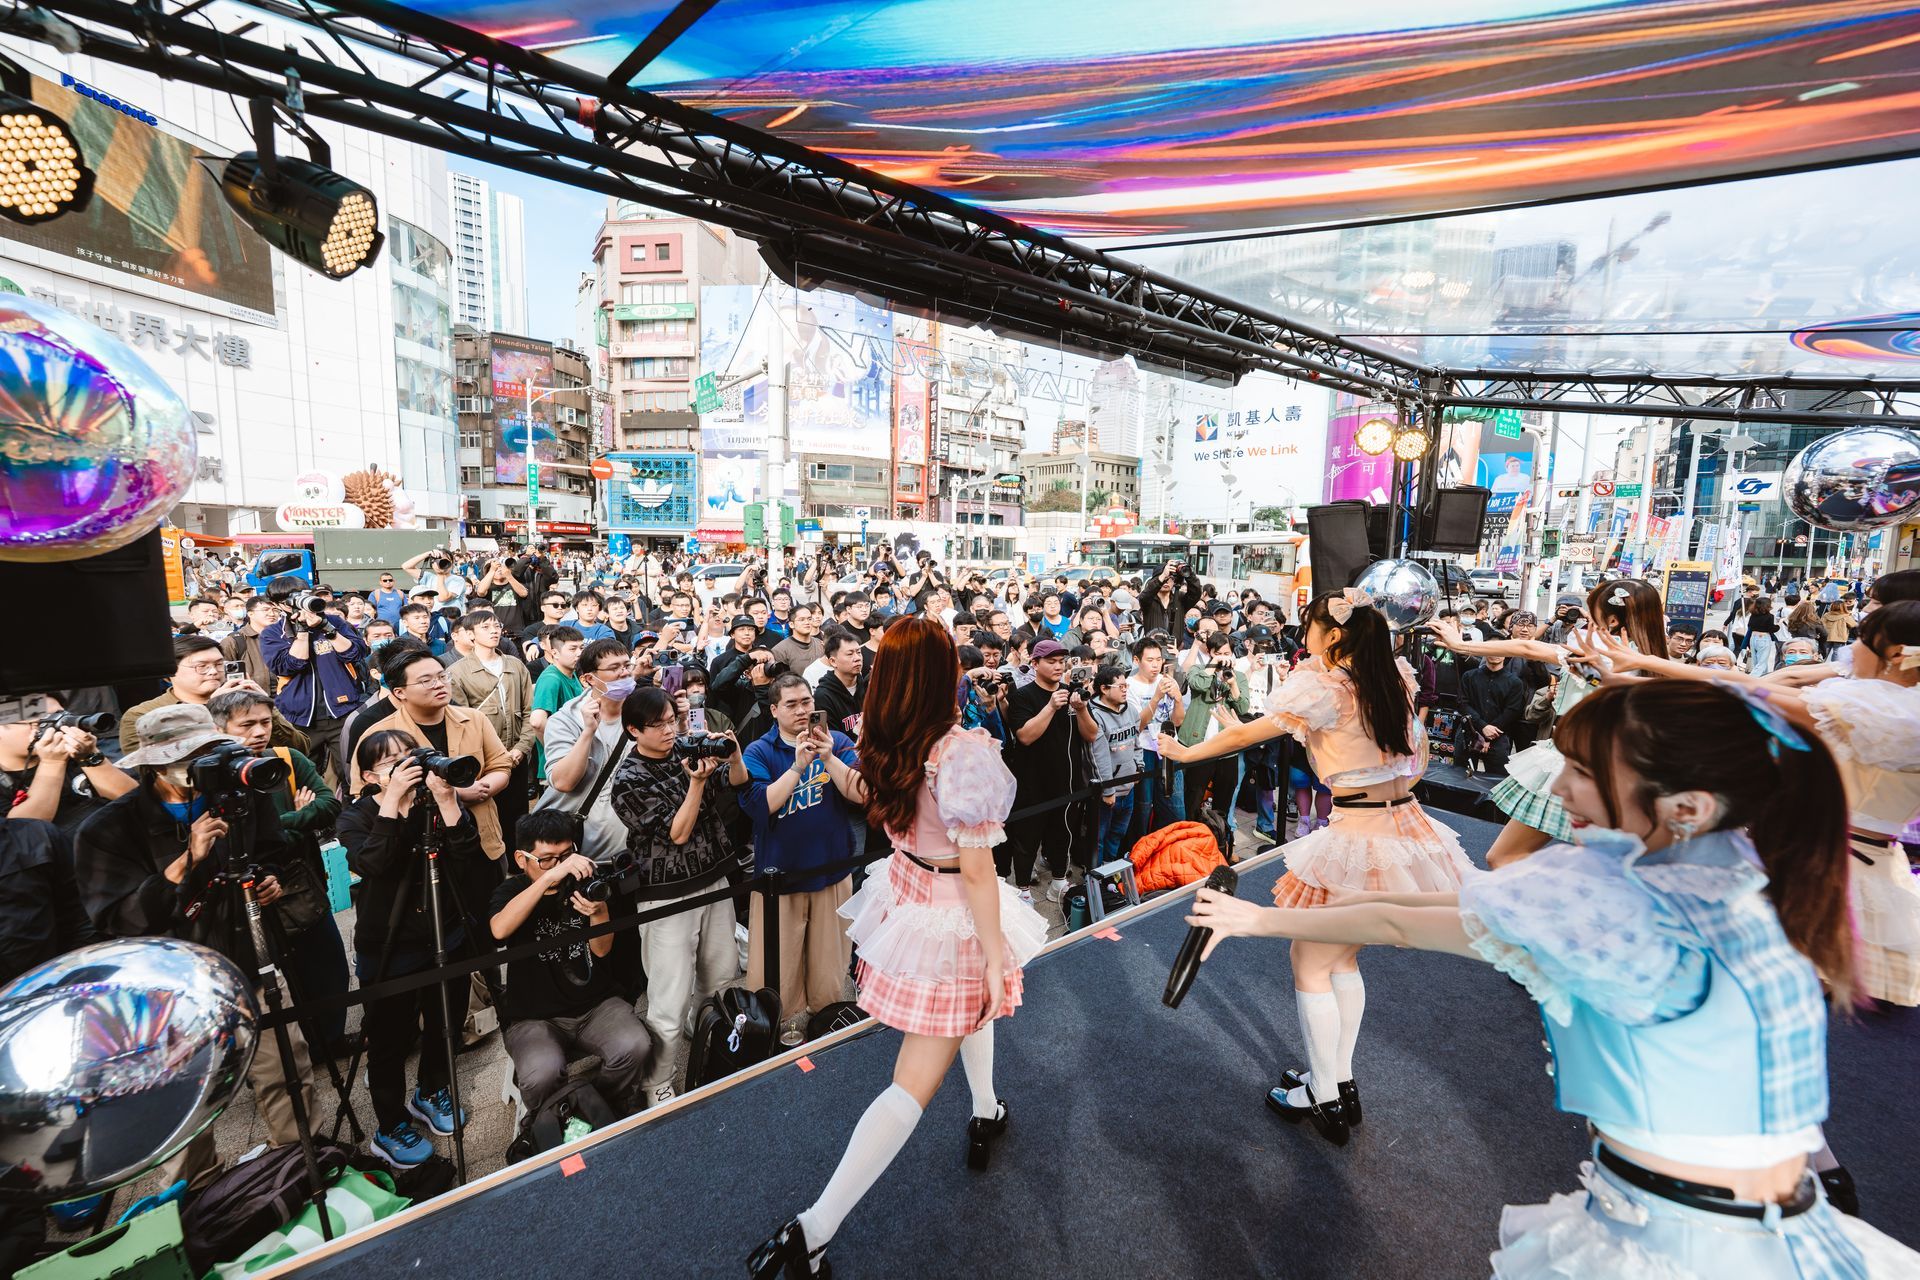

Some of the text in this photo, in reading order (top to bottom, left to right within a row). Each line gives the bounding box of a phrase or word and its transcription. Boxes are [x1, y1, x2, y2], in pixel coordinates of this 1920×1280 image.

[61, 73, 158, 126] Panasonic
[494, 338, 551, 352] Ximending Taipei
[1227, 405, 1302, 427] 凱基人壽
[1194, 452, 1210, 462] We
[1248, 447, 1267, 457] We
[1271, 444, 1299, 455] Link
[283, 505, 346, 521] MONSTER
